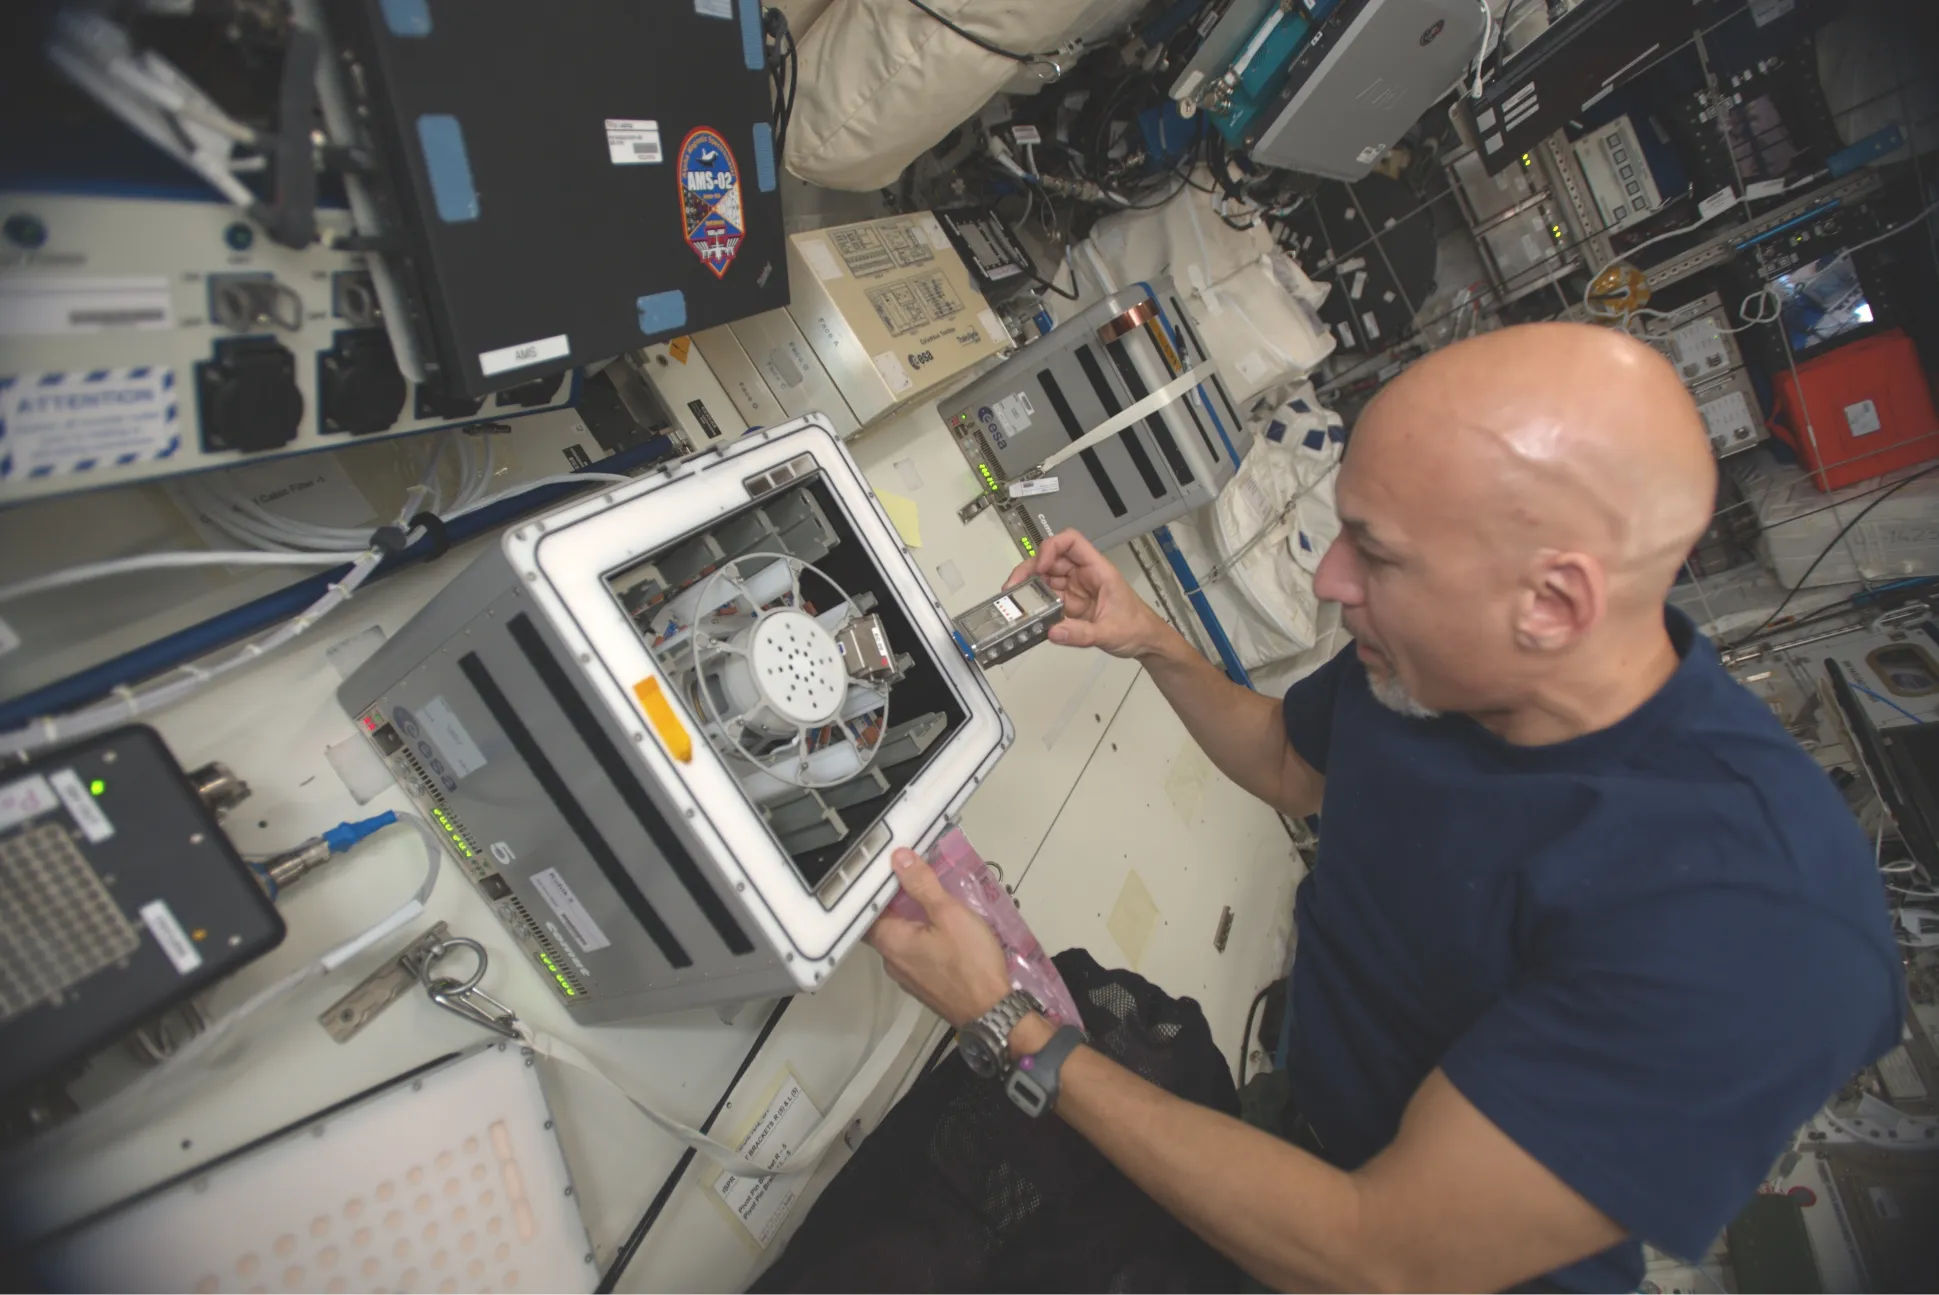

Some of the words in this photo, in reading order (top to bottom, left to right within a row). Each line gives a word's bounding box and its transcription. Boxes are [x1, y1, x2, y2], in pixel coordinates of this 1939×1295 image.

[687, 171, 733, 191] AMS-02
[817, 316, 834, 339] Face
[515, 345, 538, 360] AMS
[15, 389, 155, 416] ATTENTION
[490, 841, 516, 865] 5
[749, 1120, 775, 1157] BRACKETS
[738, 1196, 751, 1214] Pivot
[750, 1184, 760, 1197] Pin
[743, 1203, 756, 1220] Pivot
[755, 1191, 764, 1203] Pin
